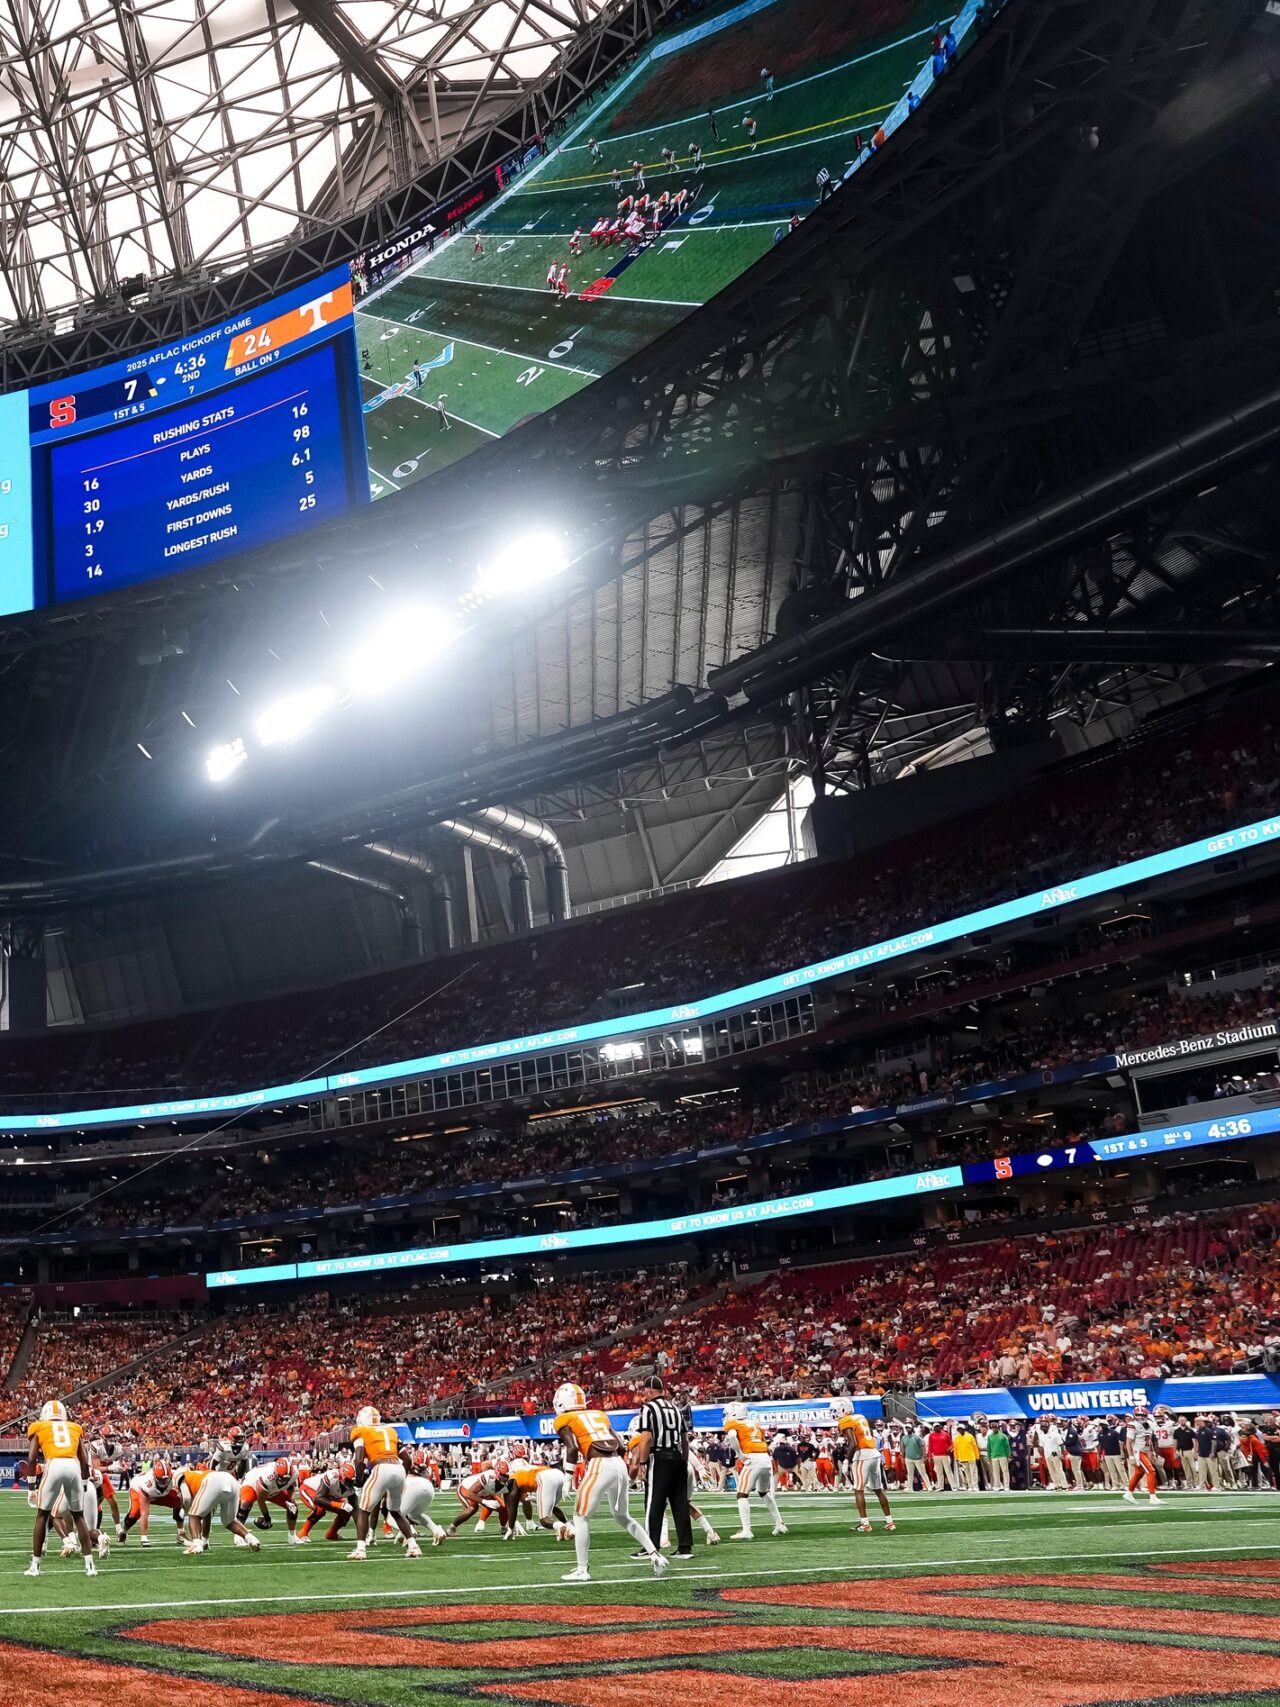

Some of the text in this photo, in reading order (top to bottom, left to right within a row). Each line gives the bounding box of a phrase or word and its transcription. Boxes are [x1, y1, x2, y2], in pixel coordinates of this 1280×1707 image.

[447, 191, 485, 220] REDZONE
[370, 223, 437, 268] HONDA
[299, 291, 333, 333] T
[126, 316, 252, 373] 2025 AFLAC KICKOFF GAME
[243, 327, 272, 357] 24
[174, 353, 207, 377] 4:36
[235, 350, 280, 377] BALL ON 9
[182, 369, 201, 384] 2ND
[124, 379, 138, 400] 7
[189, 386, 196, 395] 7
[113, 403, 146, 420] 1ST & 5
[292, 403, 308, 419] 16
[153, 407, 235, 445] RUSHING STATS
[293, 425, 310, 442] 98
[180, 443, 211, 462] PLAYS
[291, 448, 311, 467] 6.1
[83, 478, 99, 492] 16
[180, 465, 213, 484] YARDS
[305, 471, 314, 484] 5
[83, 499, 100, 514] 30
[166, 482, 230, 511] YARDS/RUSH
[299, 494, 316, 511] 25
[85, 520, 104, 535] 1.9
[167, 504, 233, 534] FIRST DOWNS
[85, 544, 94, 557] 3
[164, 525, 238, 557] LONGEST RUSH
[86, 564, 103, 579] 14
[1207, 835, 1235, 852] GET
[1238, 829, 1259, 843] TO
[1041, 886, 1079, 907] Aflac
[783, 930, 935, 986] GET TO KNOW US AT AFLAC.COM
[670, 1004, 701, 1021] Aflac
[439, 1030, 578, 1065] GET TO KNOW US AT AFLAC.COM
[1115, 1023, 1278, 1068] Mercedes-Benz Stadium
[337, 1072, 362, 1087] Aflac
[1163, 1130, 1193, 1142] BALL 9
[1207, 1118, 1252, 1140] 4:36
[1064, 1148, 1077, 1164] 7
[1103, 1138, 1149, 1155] 1ST & 5
[915, 1170, 951, 1190] Aflac
[671, 1197, 814, 1232] GET TO KNOW US AT AFLAC.COM
[539, 1234, 570, 1249] Aflac
[316, 1249, 449, 1273] GET TO KNOW US AT AFLAC.COM
[577, 1412, 609, 1440] 15
[663, 1408, 677, 1430] U
[758, 1409, 832, 1423] KICKOFF GAME
[52, 1421, 71, 1448] 8
[374, 1427, 391, 1451] 7
